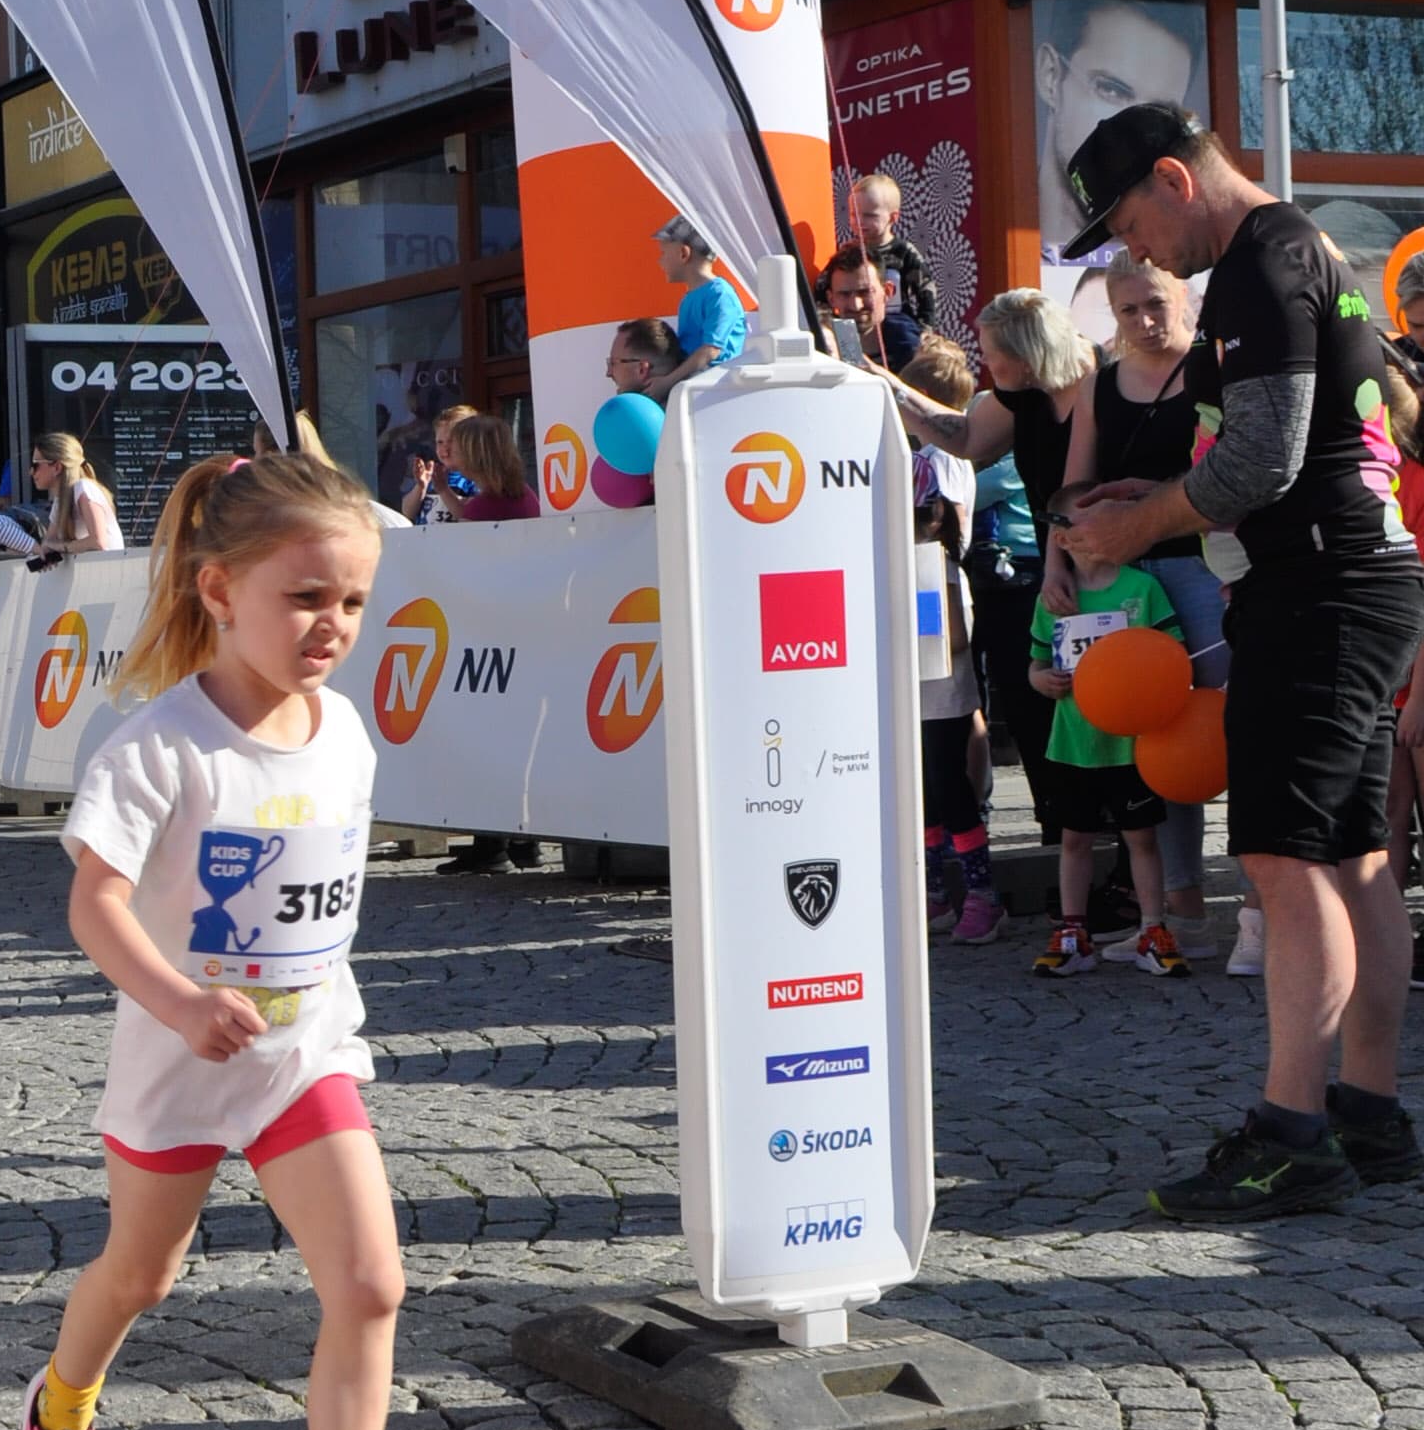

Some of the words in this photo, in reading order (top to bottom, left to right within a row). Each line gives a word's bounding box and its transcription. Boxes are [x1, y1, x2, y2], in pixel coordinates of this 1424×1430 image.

[856, 44, 923, 72] OPTIKA
[828, 67, 972, 127] UNETTES
[51, 361, 117, 392] 04
[821, 459, 871, 488] NN
[771, 640, 838, 663] AVON
[454, 647, 516, 693] NN
[832, 750, 870, 763] Powered
[832, 765, 844, 776] by
[847, 762, 870, 772] MVM
[745, 797, 804, 815] innogy
[210, 845, 252, 860] KIDS
[209, 864, 246, 878] CUP
[274, 872, 357, 924] 3185
[773, 978, 860, 1003] NUTREND
[802, 1127, 873, 1155] ŠKODA
[784, 1215, 863, 1247] KPMG
